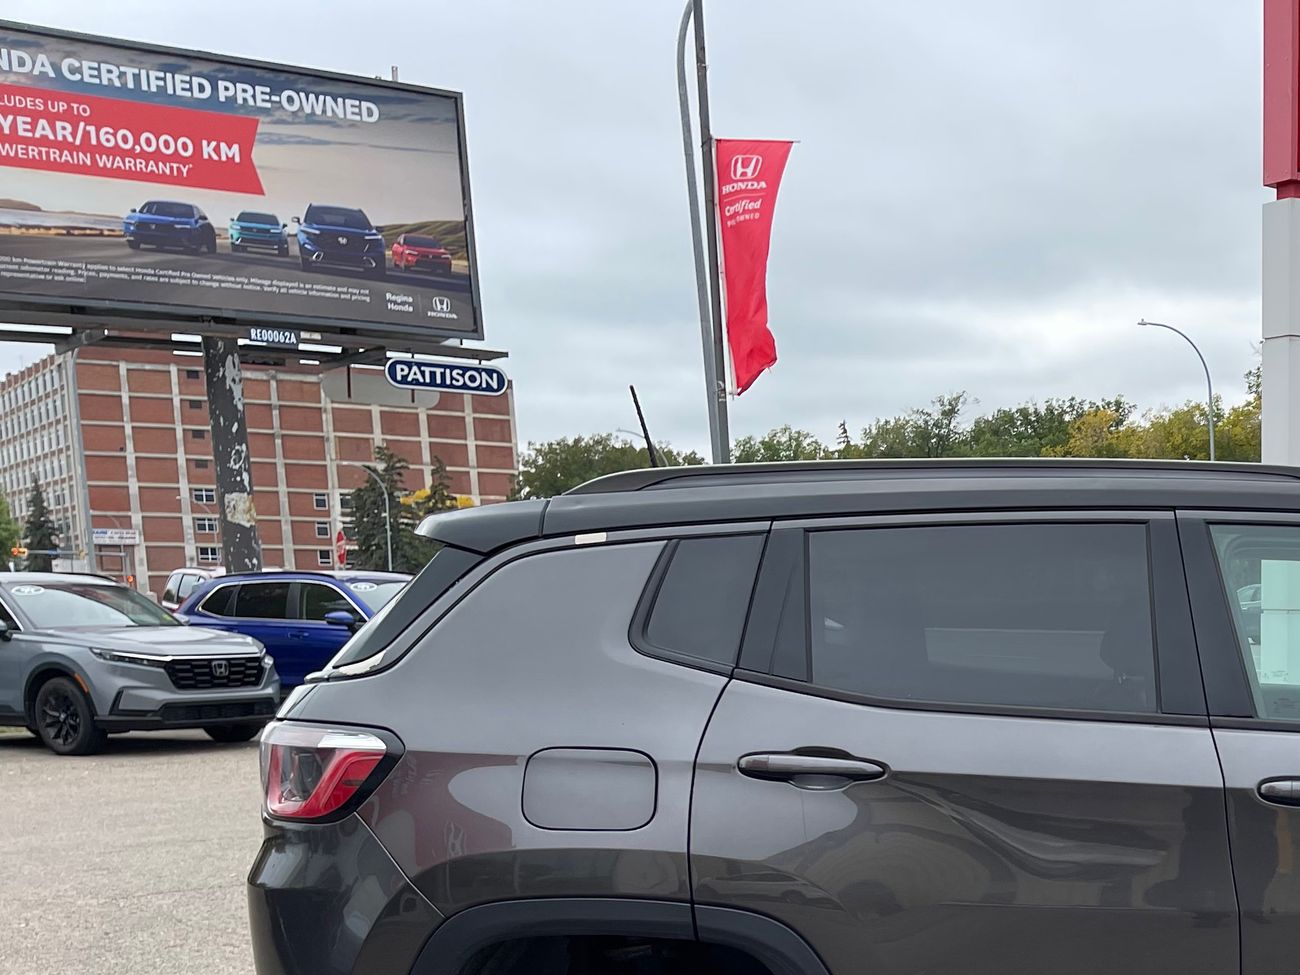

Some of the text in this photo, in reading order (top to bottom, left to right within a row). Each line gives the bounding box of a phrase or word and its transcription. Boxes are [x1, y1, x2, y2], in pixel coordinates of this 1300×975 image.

[61, 57, 212, 99] CERTIFIED
[217, 79, 380, 123] PRE-OWNED
[48, 100, 68, 113] UP
[71, 103, 91, 117] TO
[0, 113, 241, 164] YEAR/160,000 KM
[722, 181, 767, 195] HONDA
[725, 198, 762, 217] Certified
[386, 293, 413, 303] Regina
[387, 302, 414, 312] Honda
[427, 311, 458, 319] HONDA
[250, 328, 297, 344] RE00062A
[396, 364, 498, 389] PATTISON
